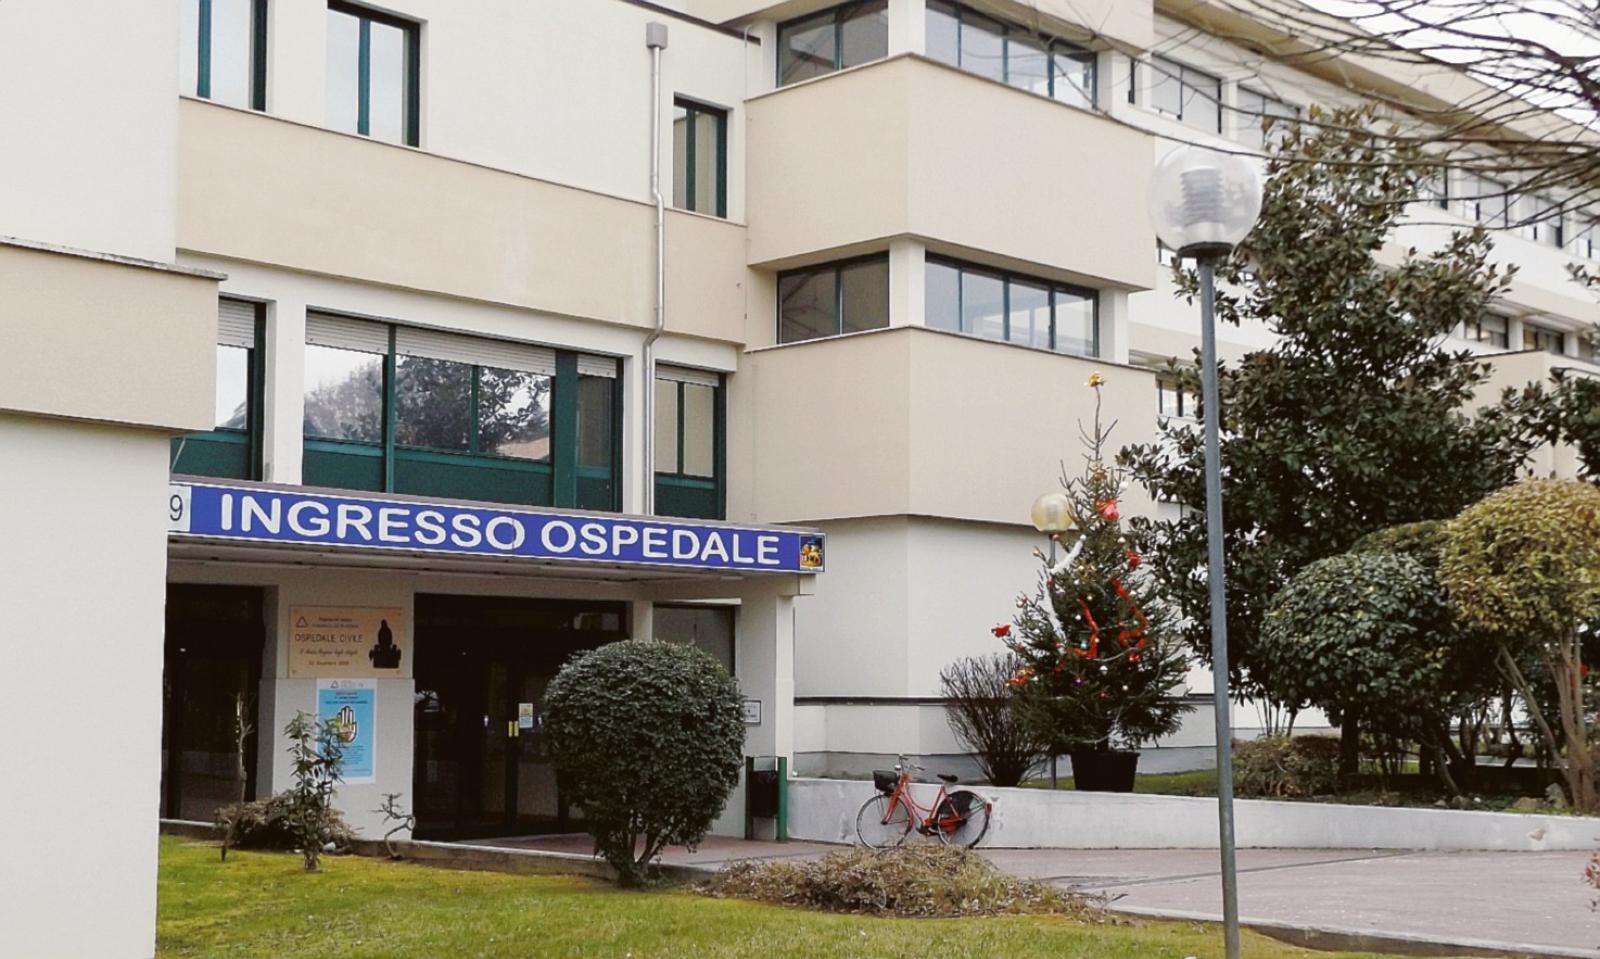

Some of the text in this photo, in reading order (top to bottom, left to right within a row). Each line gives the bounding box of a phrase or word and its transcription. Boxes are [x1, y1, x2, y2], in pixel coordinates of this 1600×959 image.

[221, 493, 781, 565] INGRESSO OSPEDALE
[294, 633, 363, 643] OSPEDALE CIVILE
